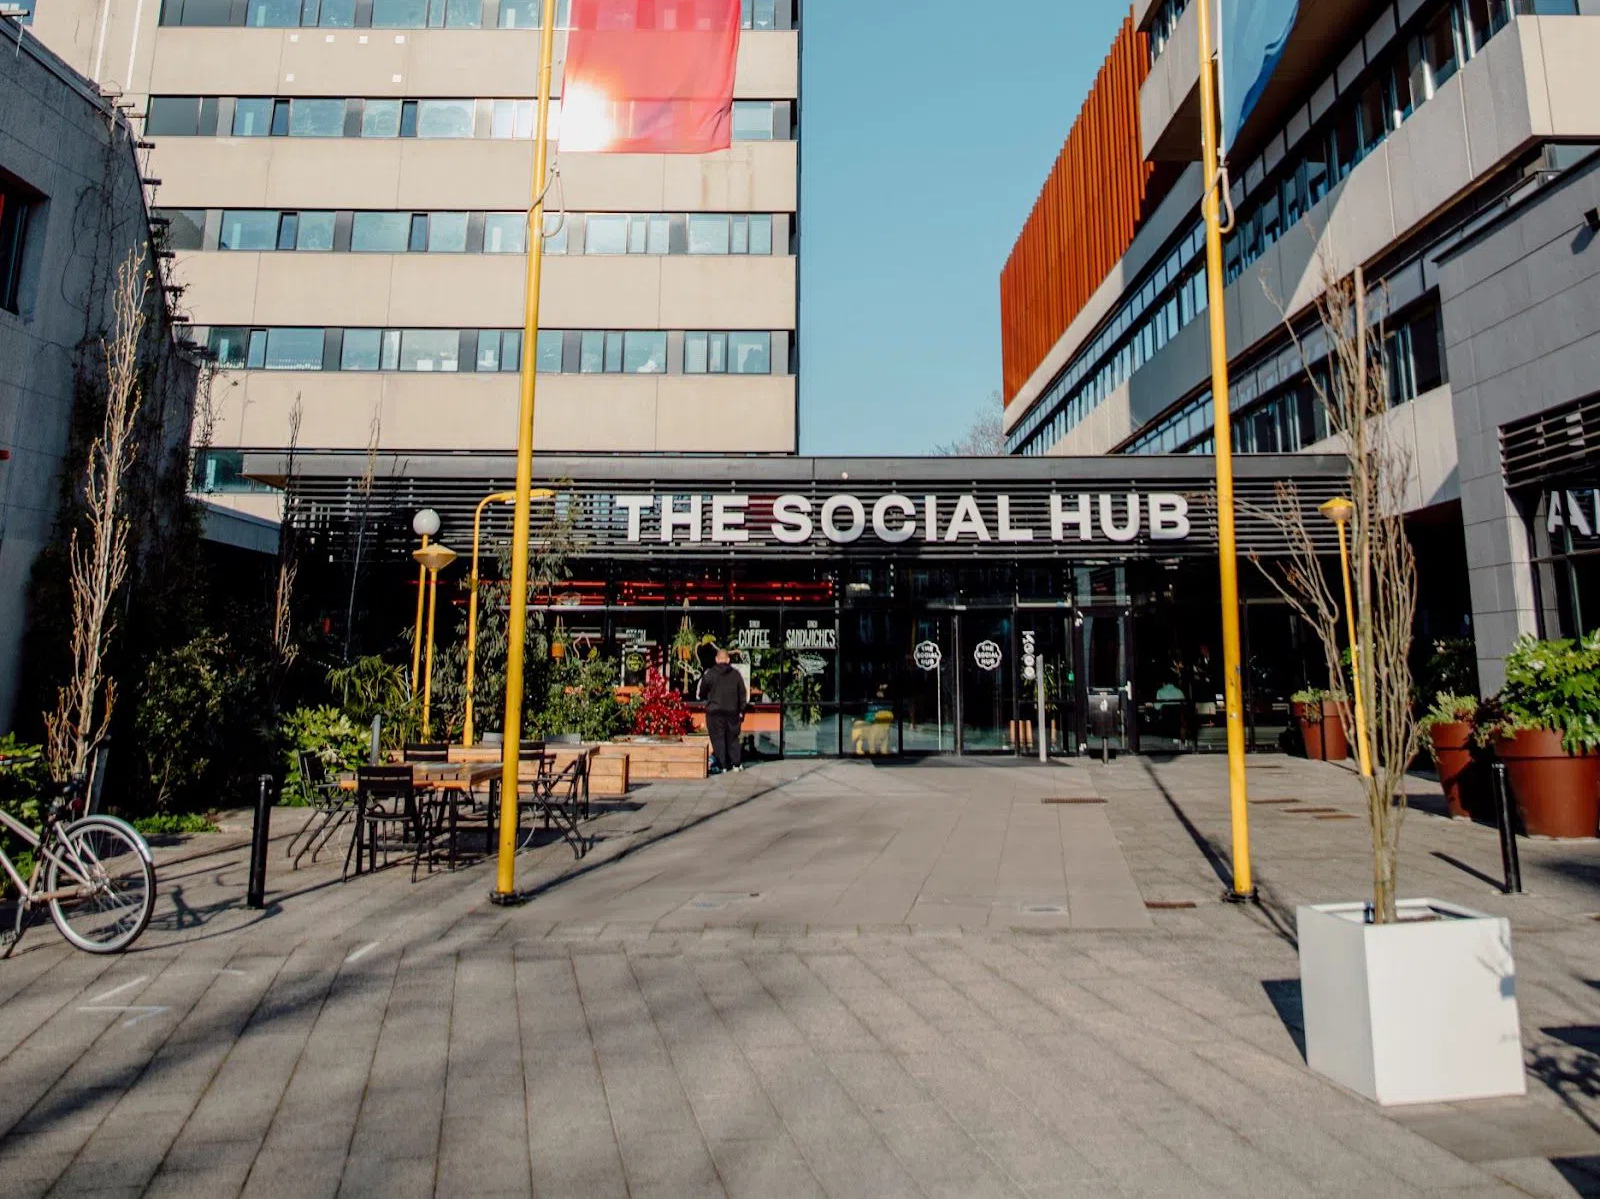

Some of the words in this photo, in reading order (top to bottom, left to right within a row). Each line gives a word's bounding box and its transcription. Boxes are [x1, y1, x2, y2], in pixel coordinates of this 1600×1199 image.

[615, 494, 750, 543] THE
[770, 493, 1034, 544] SOCIAL
[1050, 493, 1192, 543] HUB
[738, 629, 770, 649] COFFEE
[786, 629, 836, 649] SANDWICHES
